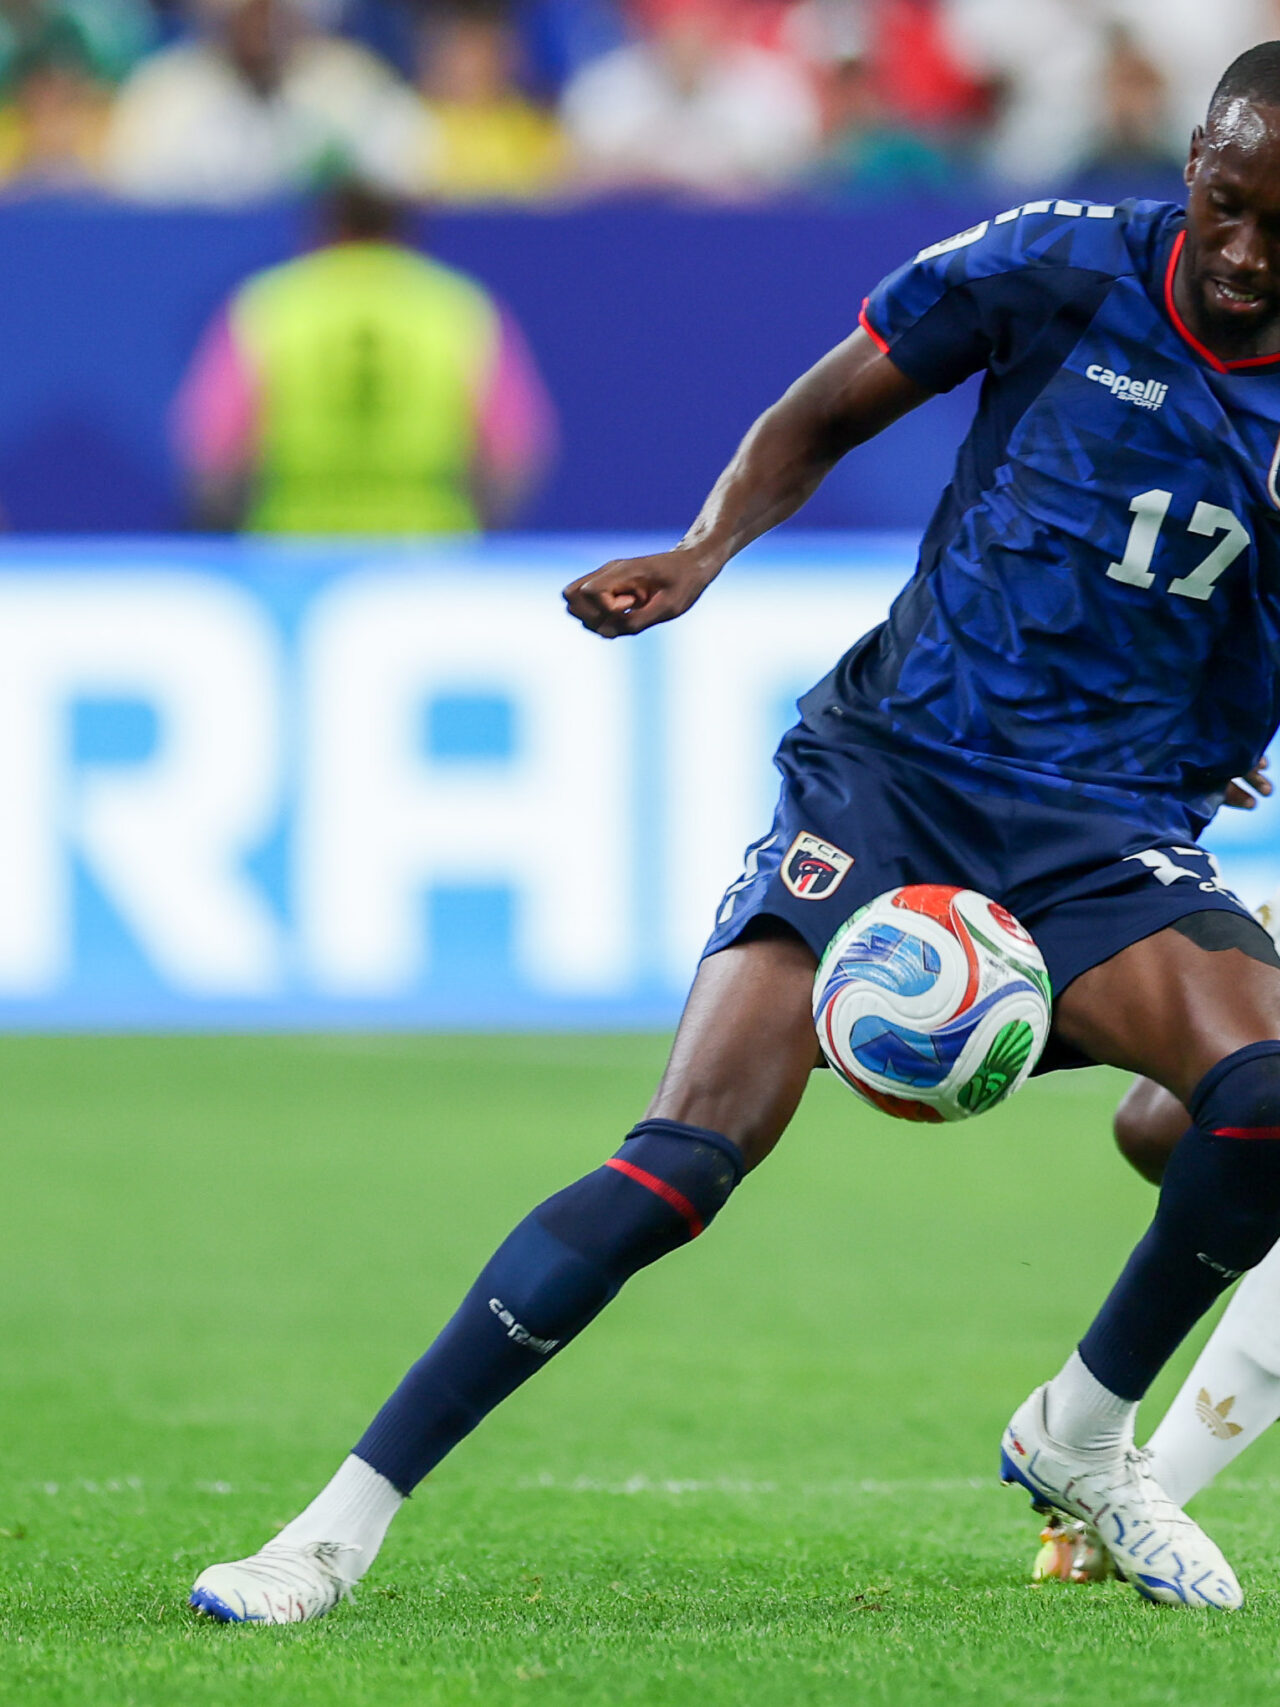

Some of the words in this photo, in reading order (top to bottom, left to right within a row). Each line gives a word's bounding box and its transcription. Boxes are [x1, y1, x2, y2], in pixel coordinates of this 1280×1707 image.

[1086, 364, 1168, 404] capelli
[1117, 391, 1161, 411] SPORT
[1105, 488, 1251, 601] 17
[803, 837, 848, 861] FCF
